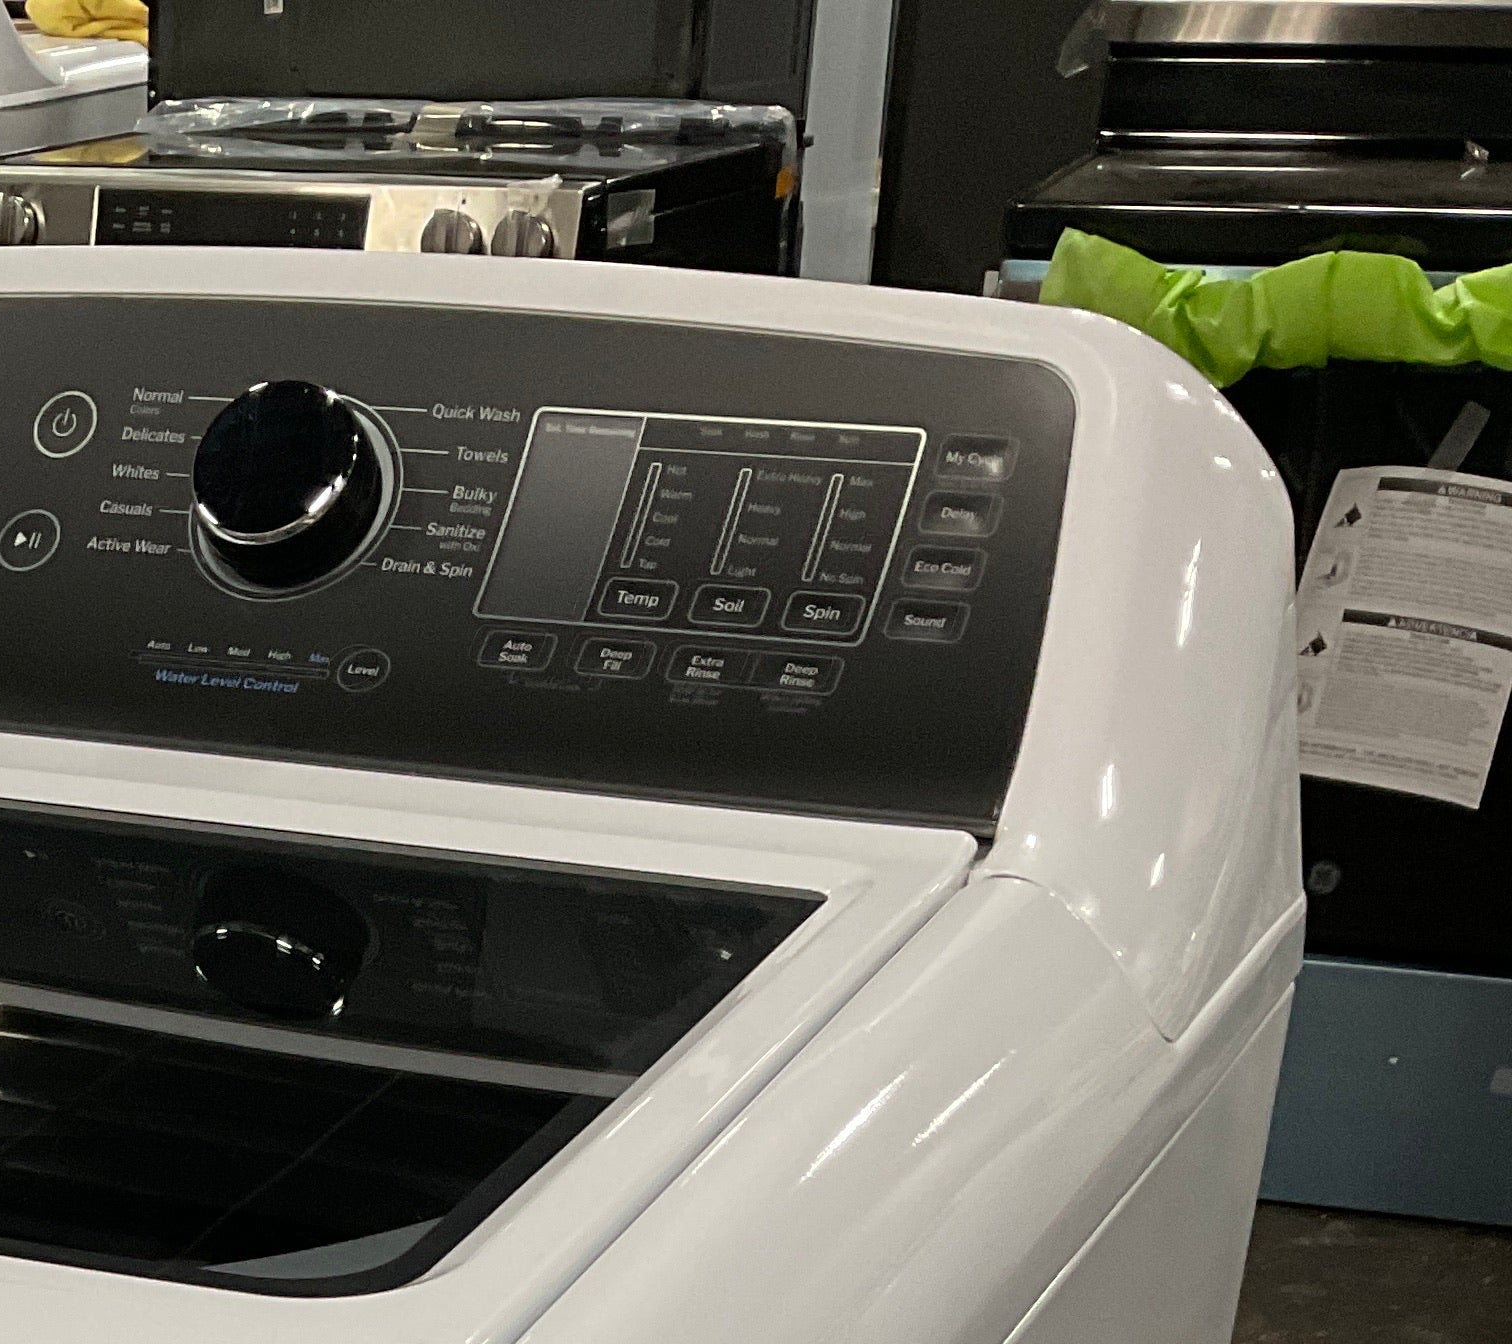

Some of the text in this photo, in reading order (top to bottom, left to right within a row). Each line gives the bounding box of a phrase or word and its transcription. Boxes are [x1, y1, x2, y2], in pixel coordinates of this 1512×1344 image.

[133, 387, 184, 404] Normal
[432, 403, 521, 423] Quick Wash
[122, 426, 186, 443] Delicates
[457, 446, 509, 464] Towels
[946, 451, 965, 466] My
[112, 463, 160, 480] Whites
[452, 485, 498, 504] Bulky
[100, 500, 153, 516] Casuals
[941, 506, 977, 522] Delay
[426, 522, 486, 540] Sanitize
[87, 536, 172, 555] Active Wear
[381, 557, 473, 578] Drain & Spin
[913, 560, 972, 577] Eco Cold
[617, 589, 660, 609] Temp
[712, 597, 745, 614] Soil
[802, 604, 841, 621] Spin
[903, 613, 947, 630] Sound
[502, 639, 533, 652] Auto
[498, 651, 529, 665] Soak
[600, 647, 633, 662] Deep
[690, 655, 725, 668] Extra
[347, 663, 380, 677] Level
[602, 659, 623, 671] Fill
[685, 666, 721, 681] Rinse
[784, 662, 820, 677] Deep
[154, 668, 301, 694] Water Level Control
[779, 674, 816, 688] Rinse
